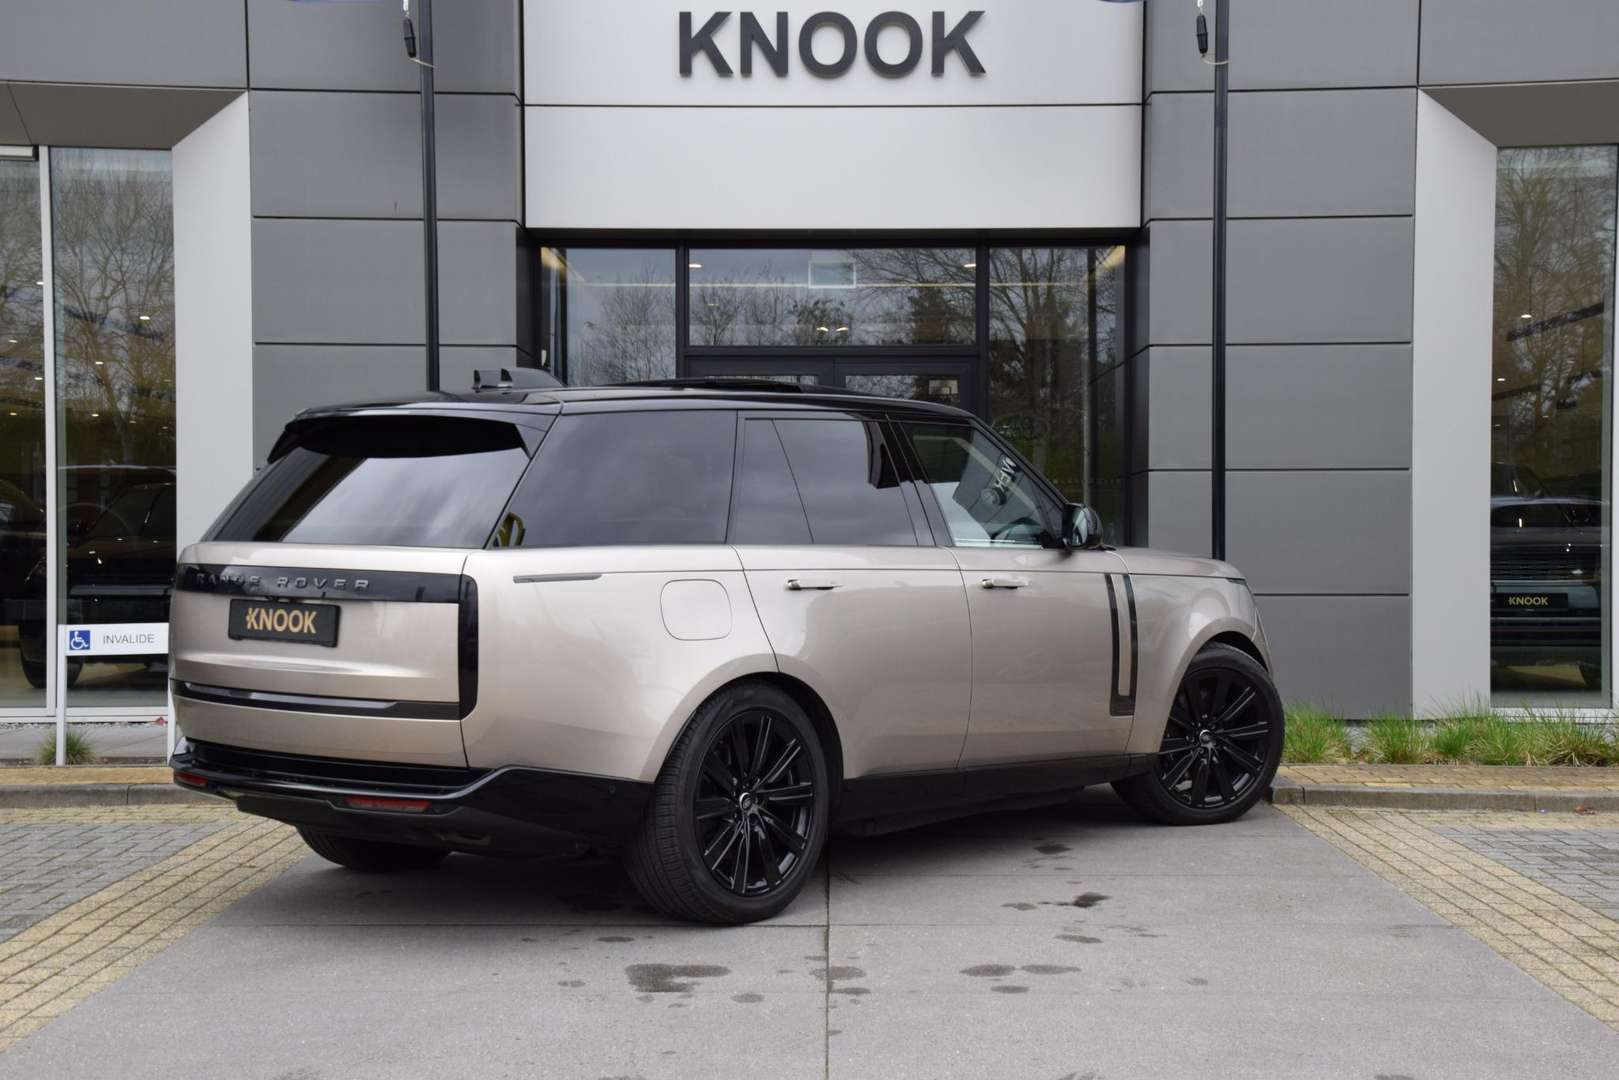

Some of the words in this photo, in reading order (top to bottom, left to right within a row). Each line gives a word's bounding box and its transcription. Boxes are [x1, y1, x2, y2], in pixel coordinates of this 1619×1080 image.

[679, 11, 986, 77] KNOOK
[276, 577, 369, 590] ROVER
[1508, 596, 1549, 606] KNOOK
[246, 607, 317, 634] KNOOK
[103, 633, 155, 645] INVALIDE
